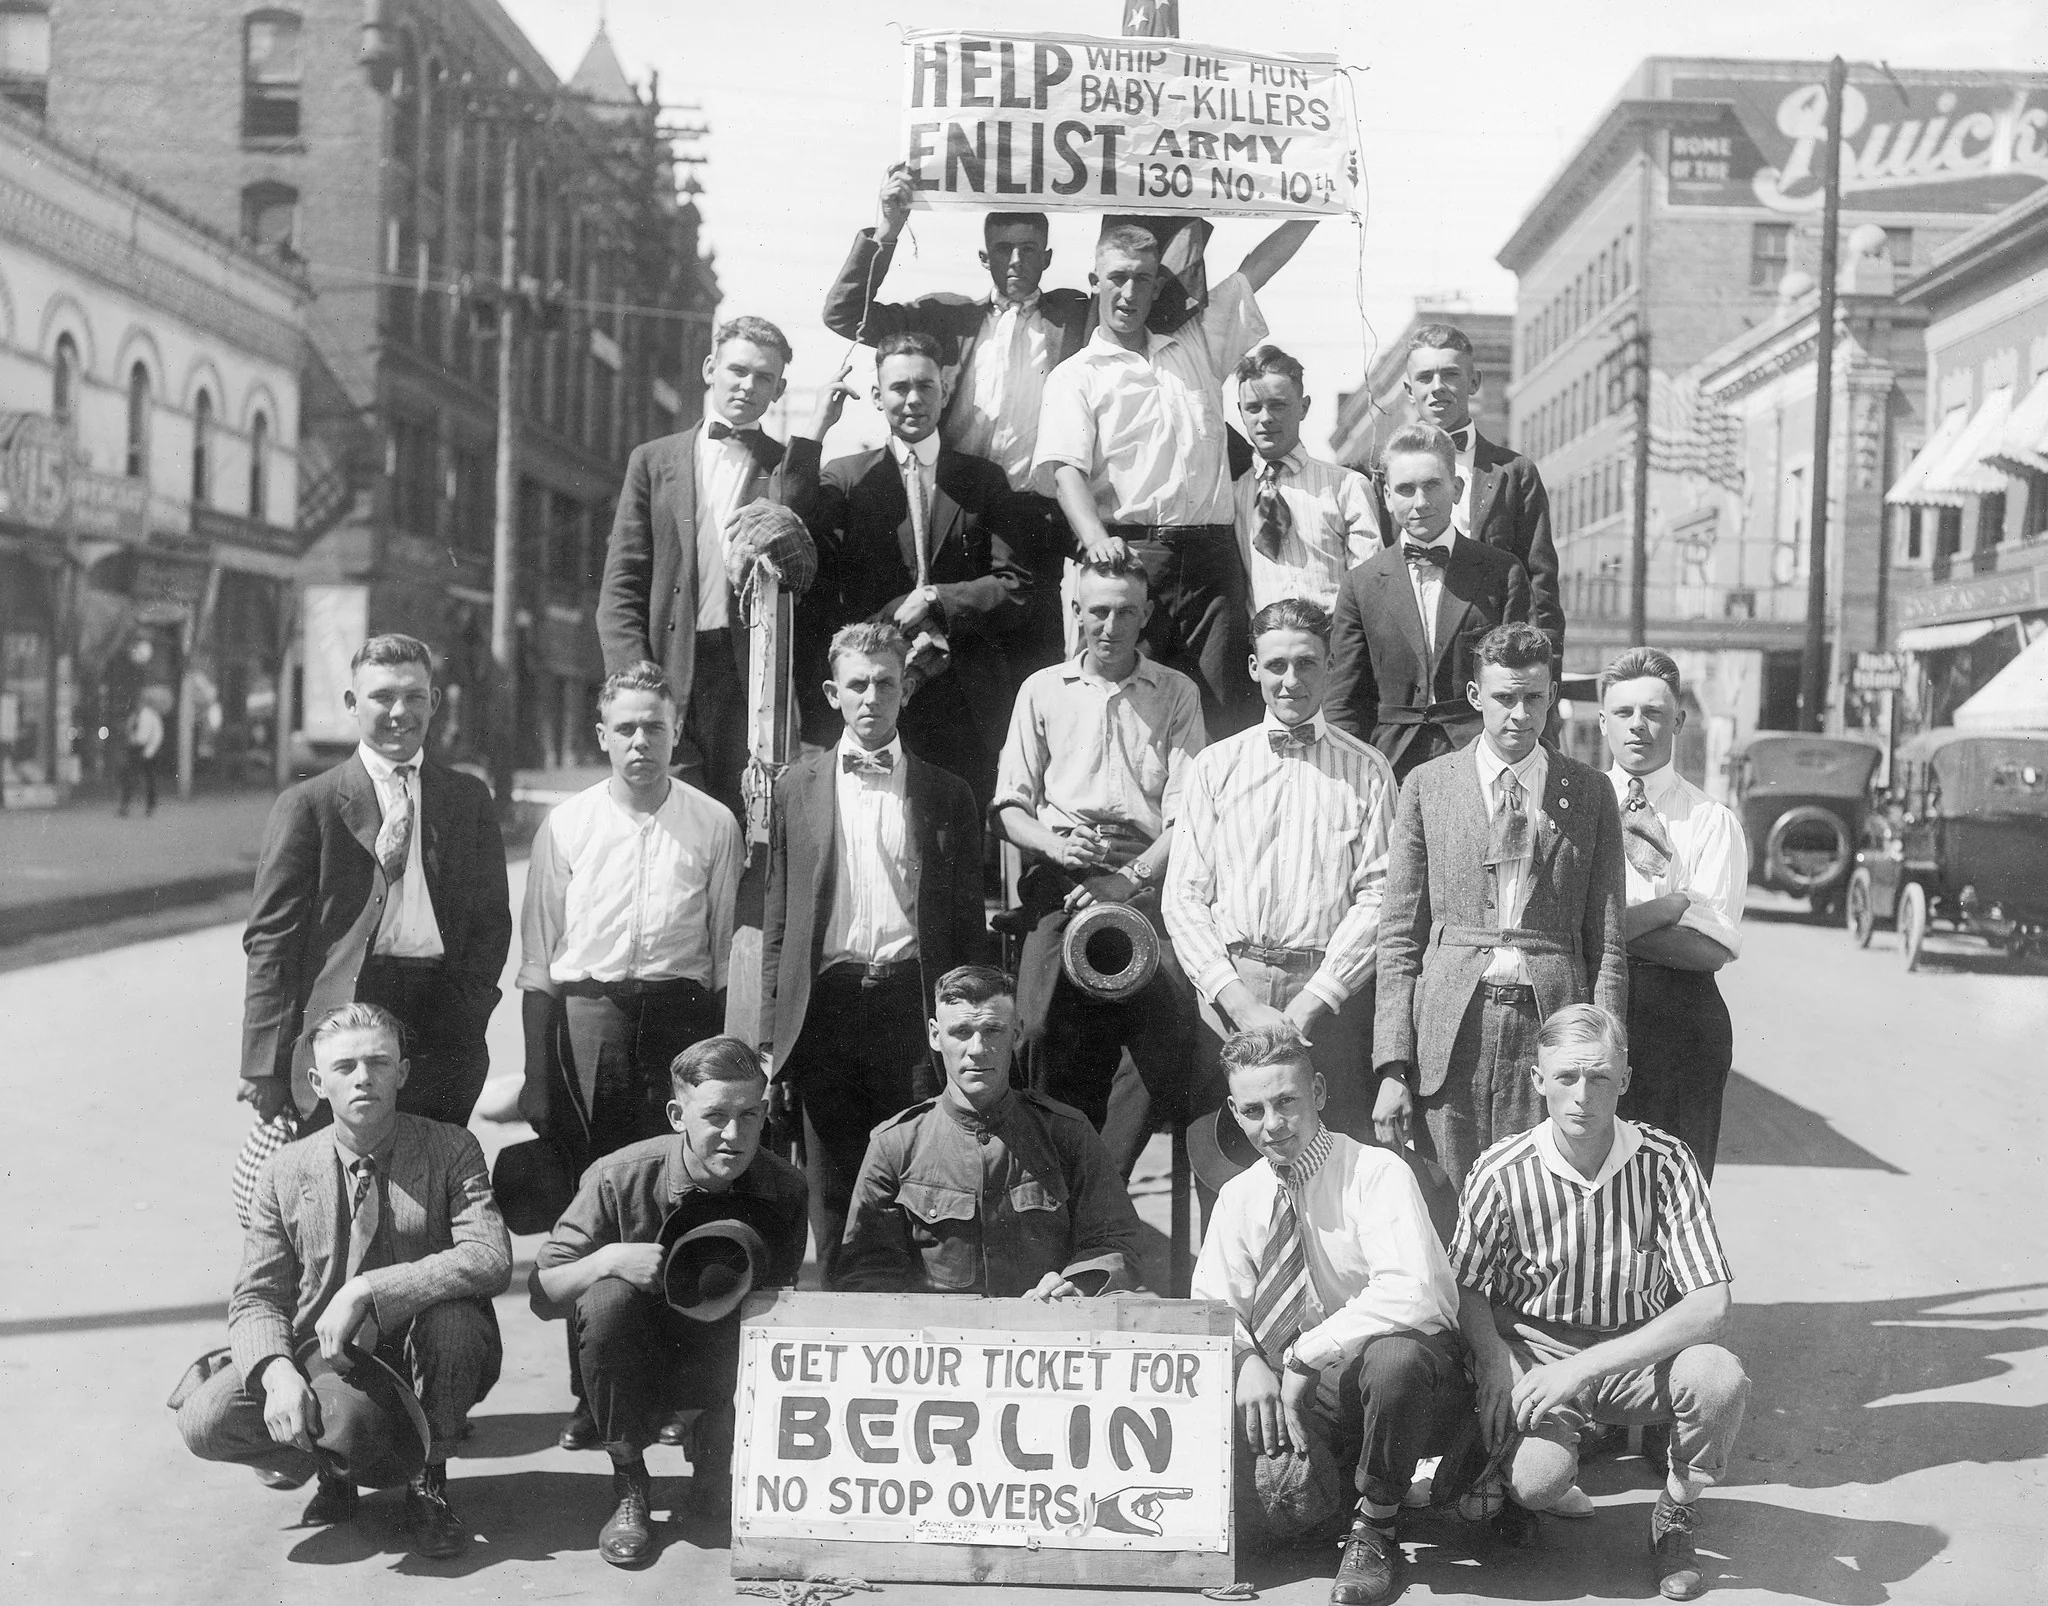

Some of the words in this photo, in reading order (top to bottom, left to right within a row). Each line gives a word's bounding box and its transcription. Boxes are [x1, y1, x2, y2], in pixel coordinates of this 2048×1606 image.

[911, 41, 1073, 110] HELP
[1085, 46, 1167, 73] WHIP
[1250, 63, 1309, 91] HUN
[1081, 74, 1331, 131] BABY-KILLERS
[909, 120, 1126, 195] ENLIST
[1149, 128, 1292, 165] ARMY
[1752, 83, 2048, 213] Buick
[1138, 162, 1193, 198] 130
[771, 1342, 848, 1383] GET
[861, 1345, 963, 1387] YOUR
[983, 1348, 1112, 1392] TICKET
[1130, 1352, 1201, 1398] FOR
[777, 1396, 1174, 1474] BERLIN
[756, 1475, 809, 1513] NO
[829, 1476, 935, 1516] STOP
[947, 1481, 1081, 1531] OVERS
